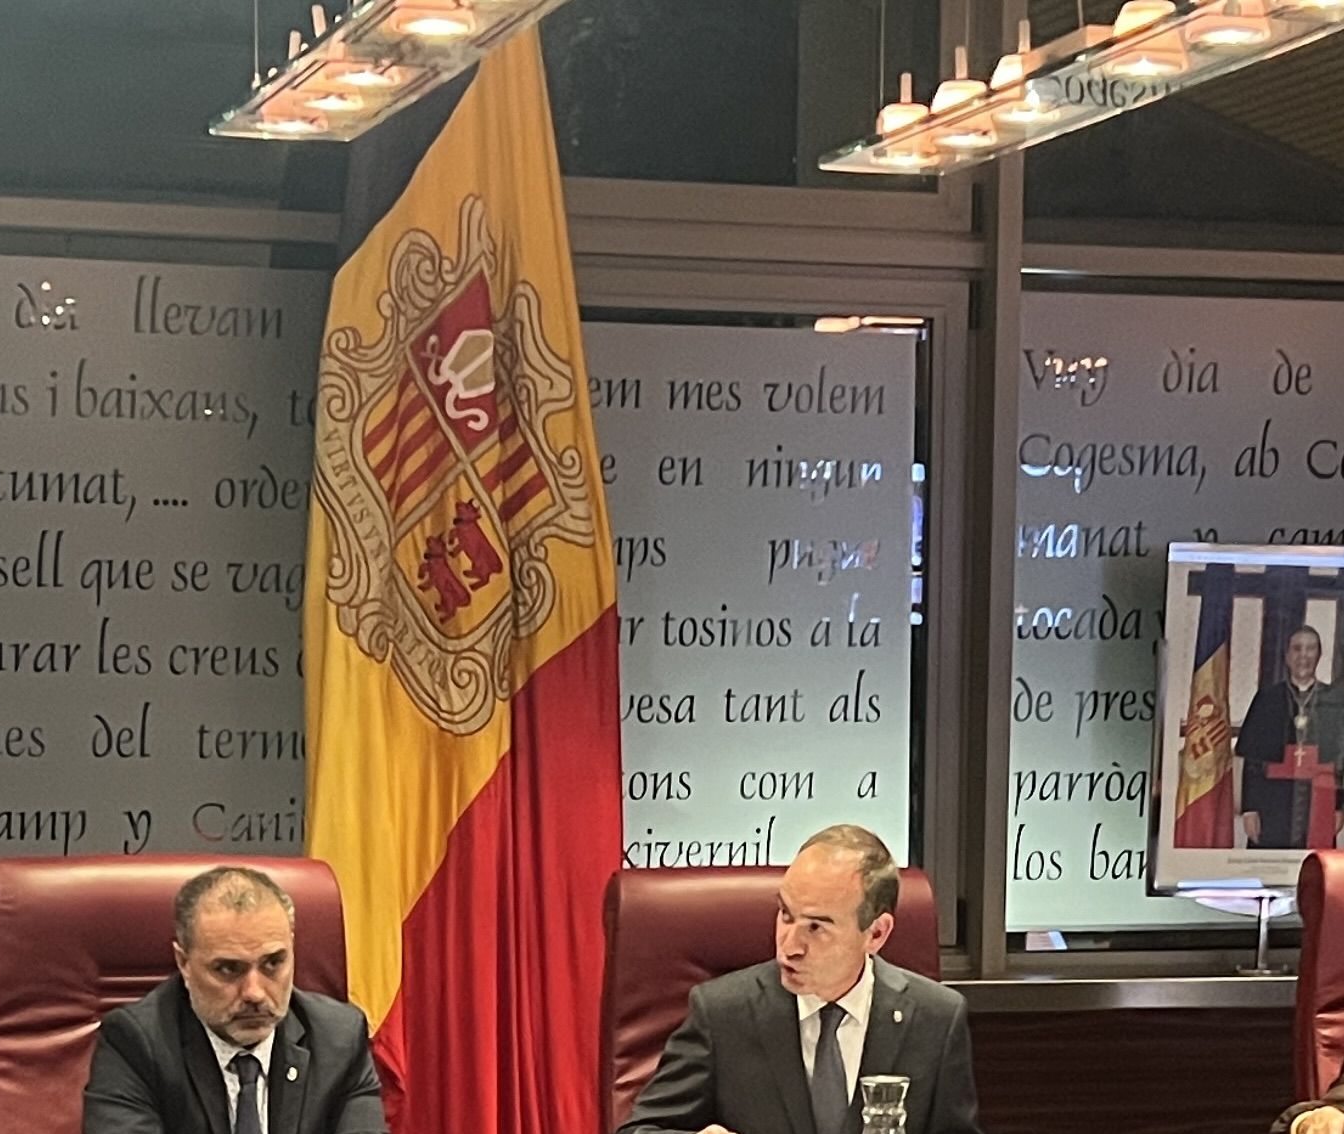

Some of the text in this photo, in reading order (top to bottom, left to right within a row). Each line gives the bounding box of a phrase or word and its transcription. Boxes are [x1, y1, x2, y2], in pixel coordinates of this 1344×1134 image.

[46, 370, 58, 417] i
[667, 378, 742, 412] mes
[763, 364, 886, 415] volem
[1163, 347, 1219, 394] dia
[1273, 348, 1313, 396] de
[658, 453, 704, 487] en
[1019, 433, 1206, 495] Cogesma,
[1235, 418, 1280, 479] ab
[613, 535, 667, 583] ps
[1017, 520, 1150, 559] manat
[80, 556, 156, 607] que
[171, 555, 211, 593] se
[661, 603, 792, 648] tosinos
[810, 616, 832, 648] a
[847, 592, 882, 648] la
[1014, 594, 1142, 641] tocada
[99, 618, 153, 677] les
[168, 639, 280, 678] creus
[724, 688, 806, 724] tant
[829, 669, 882, 724] als
[1013, 676, 1054, 723] de
[92, 703, 152, 761] del
[197, 723, 305, 761] term
[623, 770, 878, 801] ons com a
[123, 810, 153, 852] y
[1012, 823, 1063, 881] los
